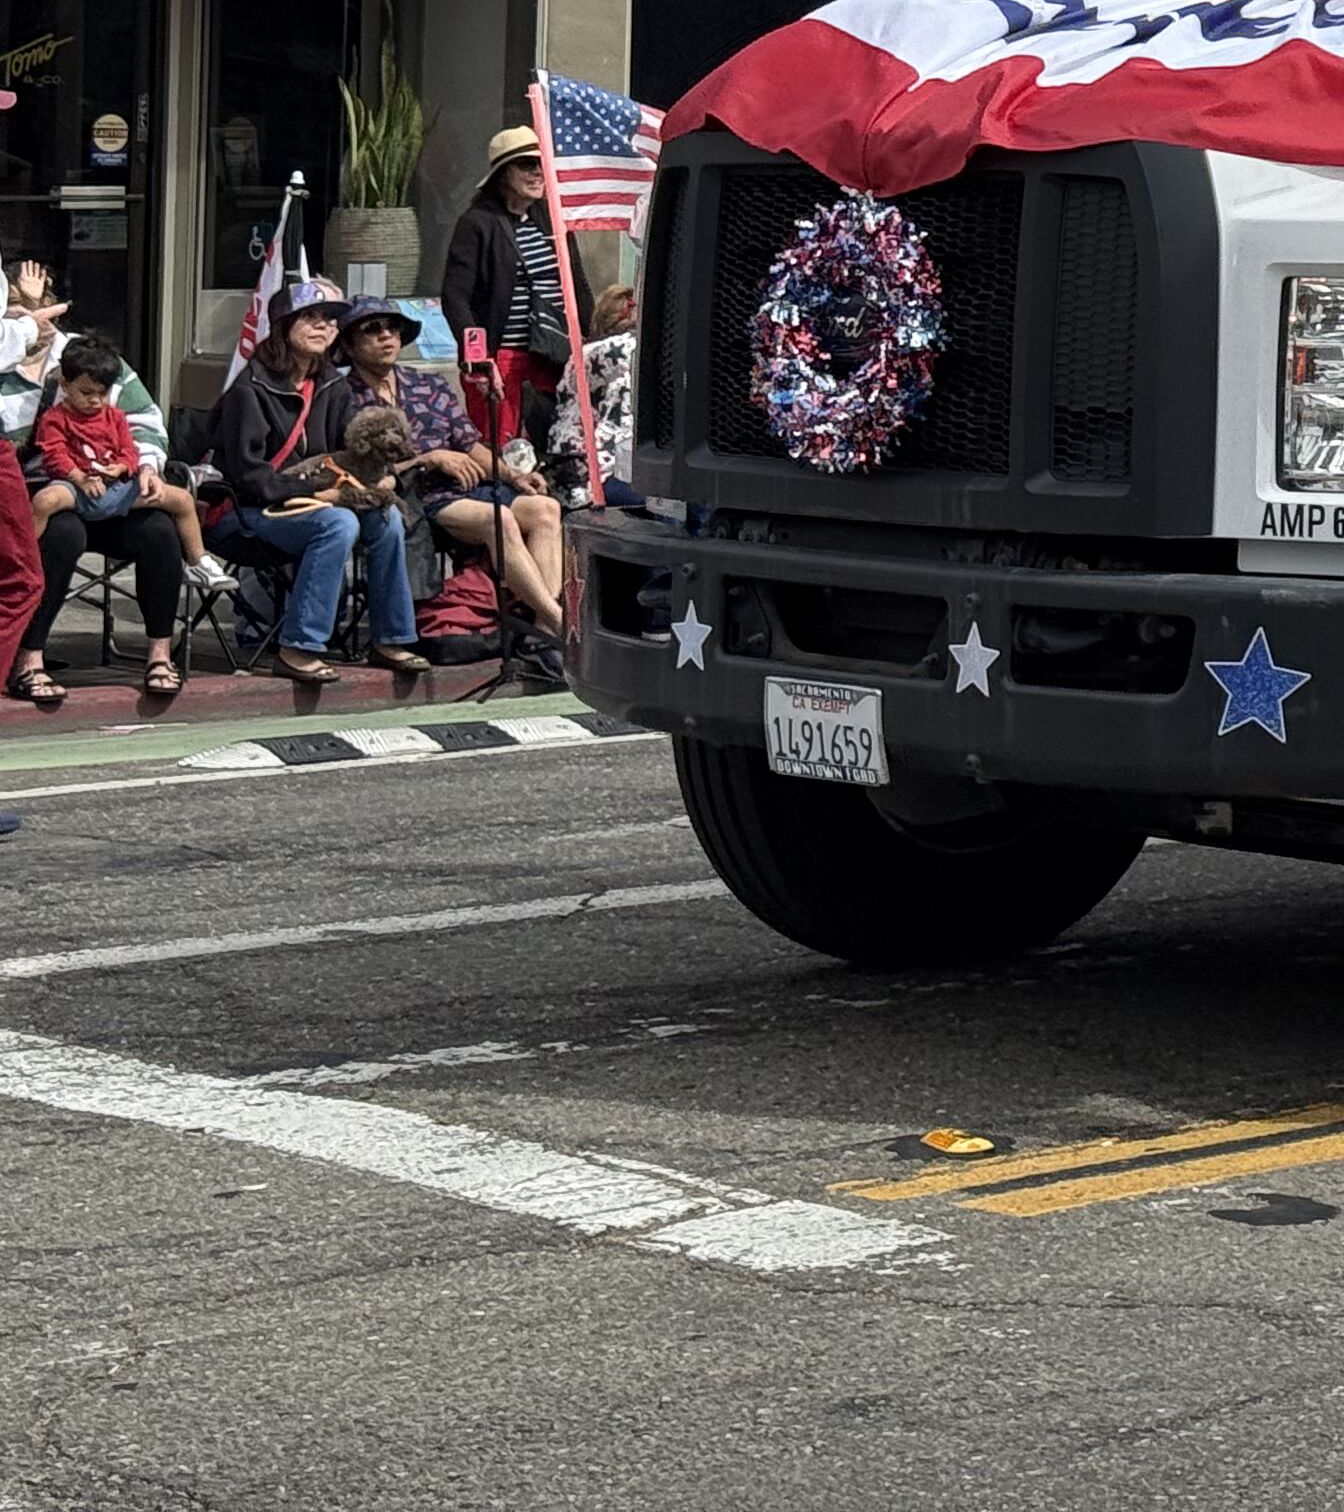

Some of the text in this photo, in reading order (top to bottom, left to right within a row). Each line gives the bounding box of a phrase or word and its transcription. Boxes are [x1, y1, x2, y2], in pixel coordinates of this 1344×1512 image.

[1260, 502, 1326, 538] AMP
[773, 716, 873, 769] 1491659
[776, 757, 844, 780] DOWNTOWN
